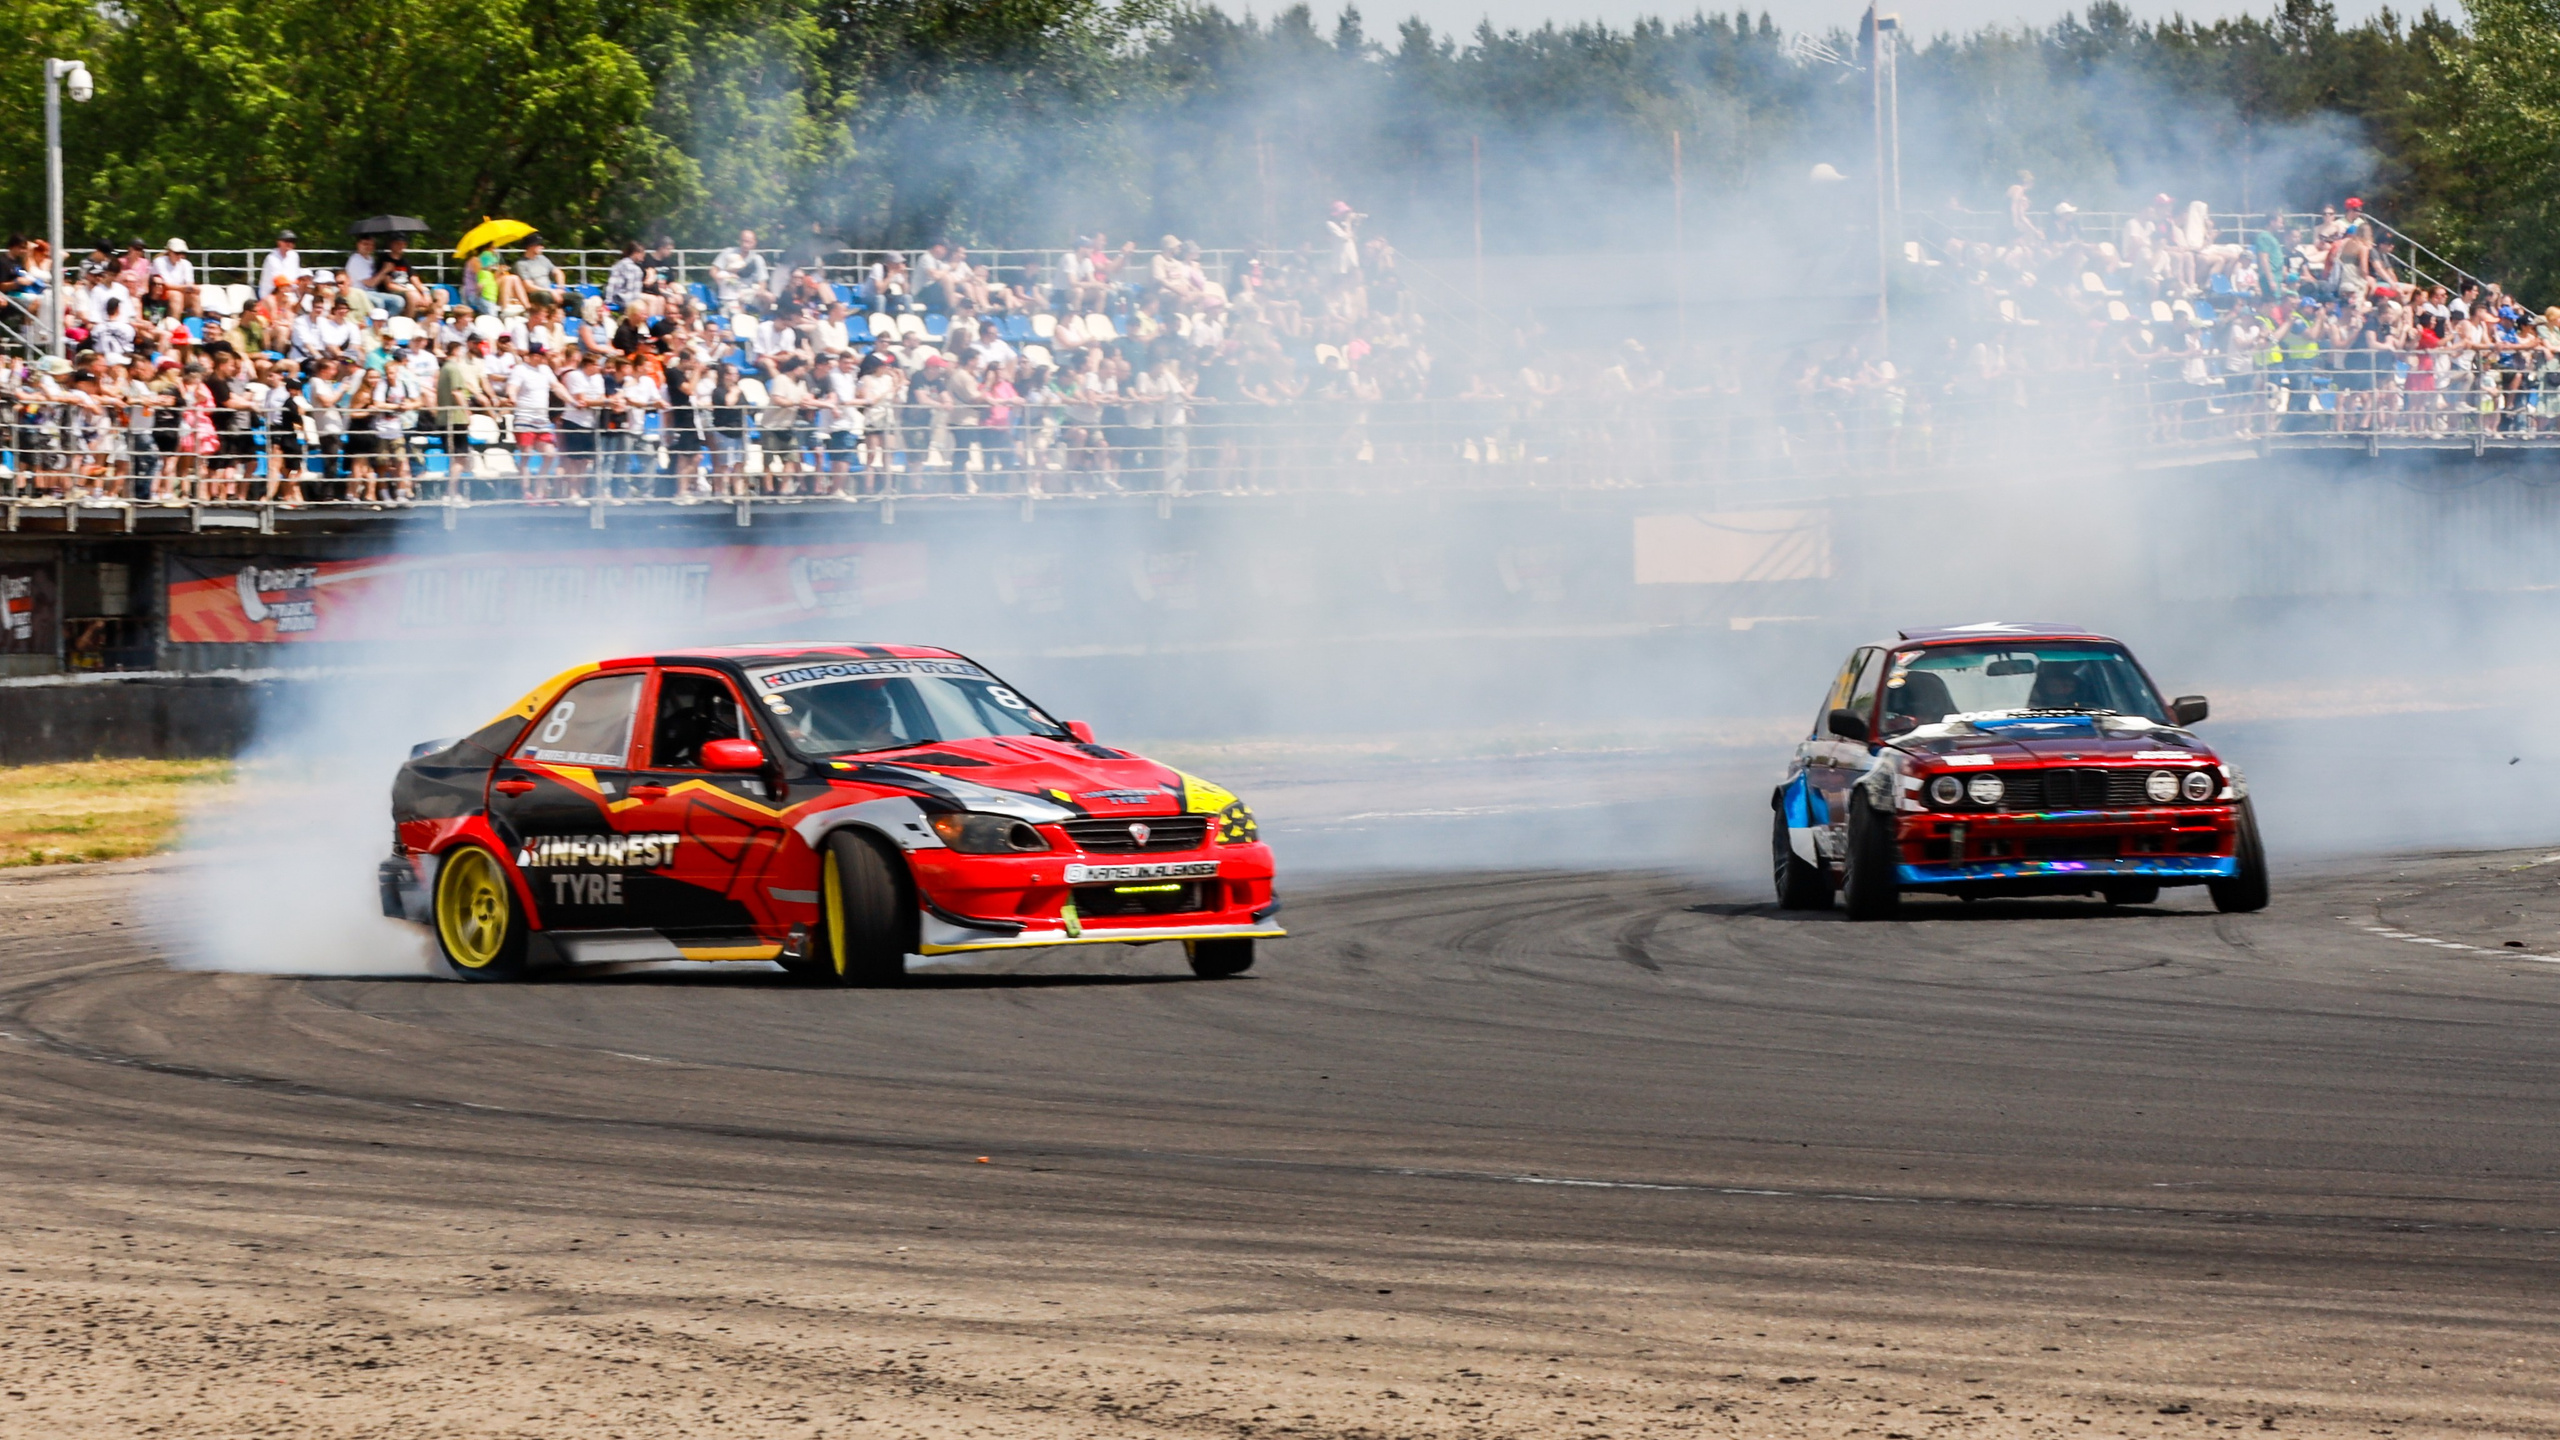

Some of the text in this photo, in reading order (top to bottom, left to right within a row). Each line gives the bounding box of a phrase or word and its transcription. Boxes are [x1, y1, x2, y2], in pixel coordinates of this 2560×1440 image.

[258, 567, 318, 592] DRIFT
[633, 563, 711, 621] DRIFT
[761, 659, 985, 689] KINFOREST TYRE
[985, 685, 1028, 710] 8
[542, 700, 576, 743] 8
[516, 834, 680, 868] KINFOREST
[551, 873, 625, 906] TYRE
